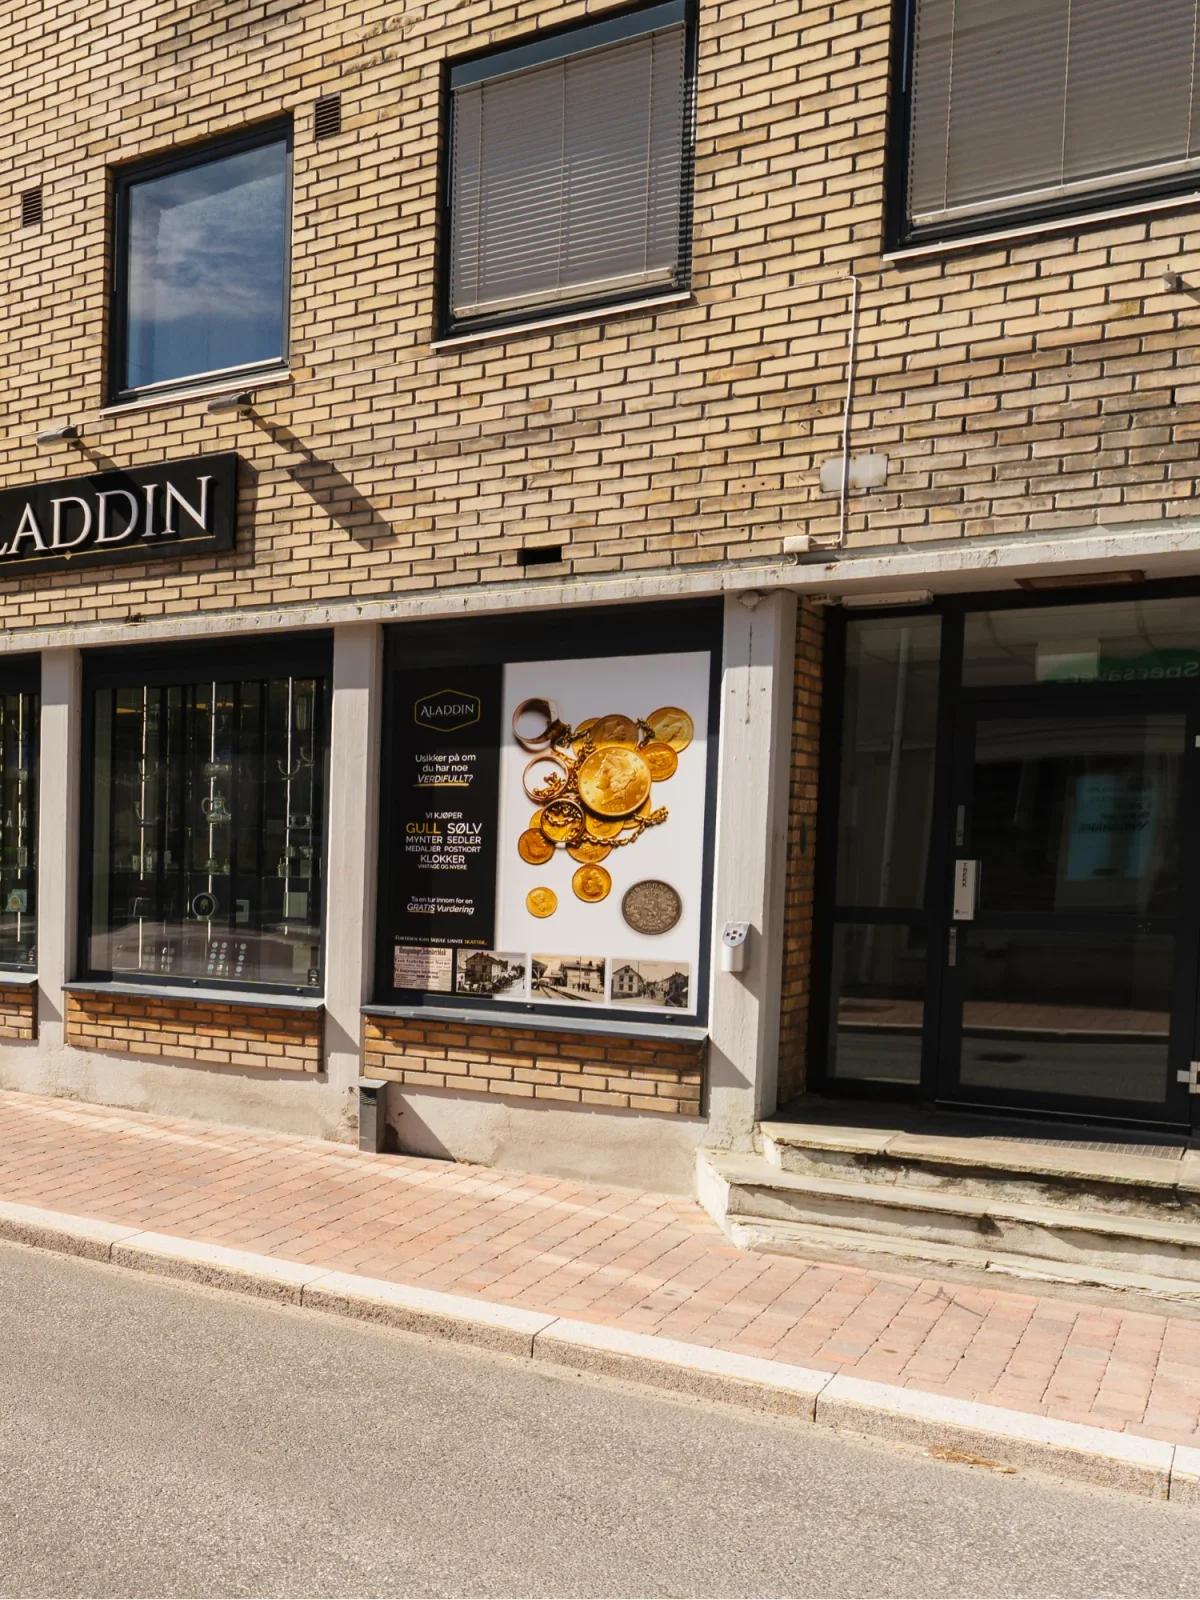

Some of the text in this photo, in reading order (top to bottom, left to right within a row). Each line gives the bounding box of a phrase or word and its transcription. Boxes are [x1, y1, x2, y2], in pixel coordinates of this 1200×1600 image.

[420, 704, 474, 718] ALADDIN
[415, 754, 447, 762] Usikker
[448, 753, 460, 763] på
[422, 764, 433, 772] du
[436, 764, 450, 772] har
[418, 774, 473, 783] VERDIFULLT?
[406, 823, 482, 834] GULL SØLV
[406, 836, 481, 844] MYNTER SEDLER
[420, 855, 465, 863] KLOKKER
[407, 903, 474, 915] GRATIS Vurdering
